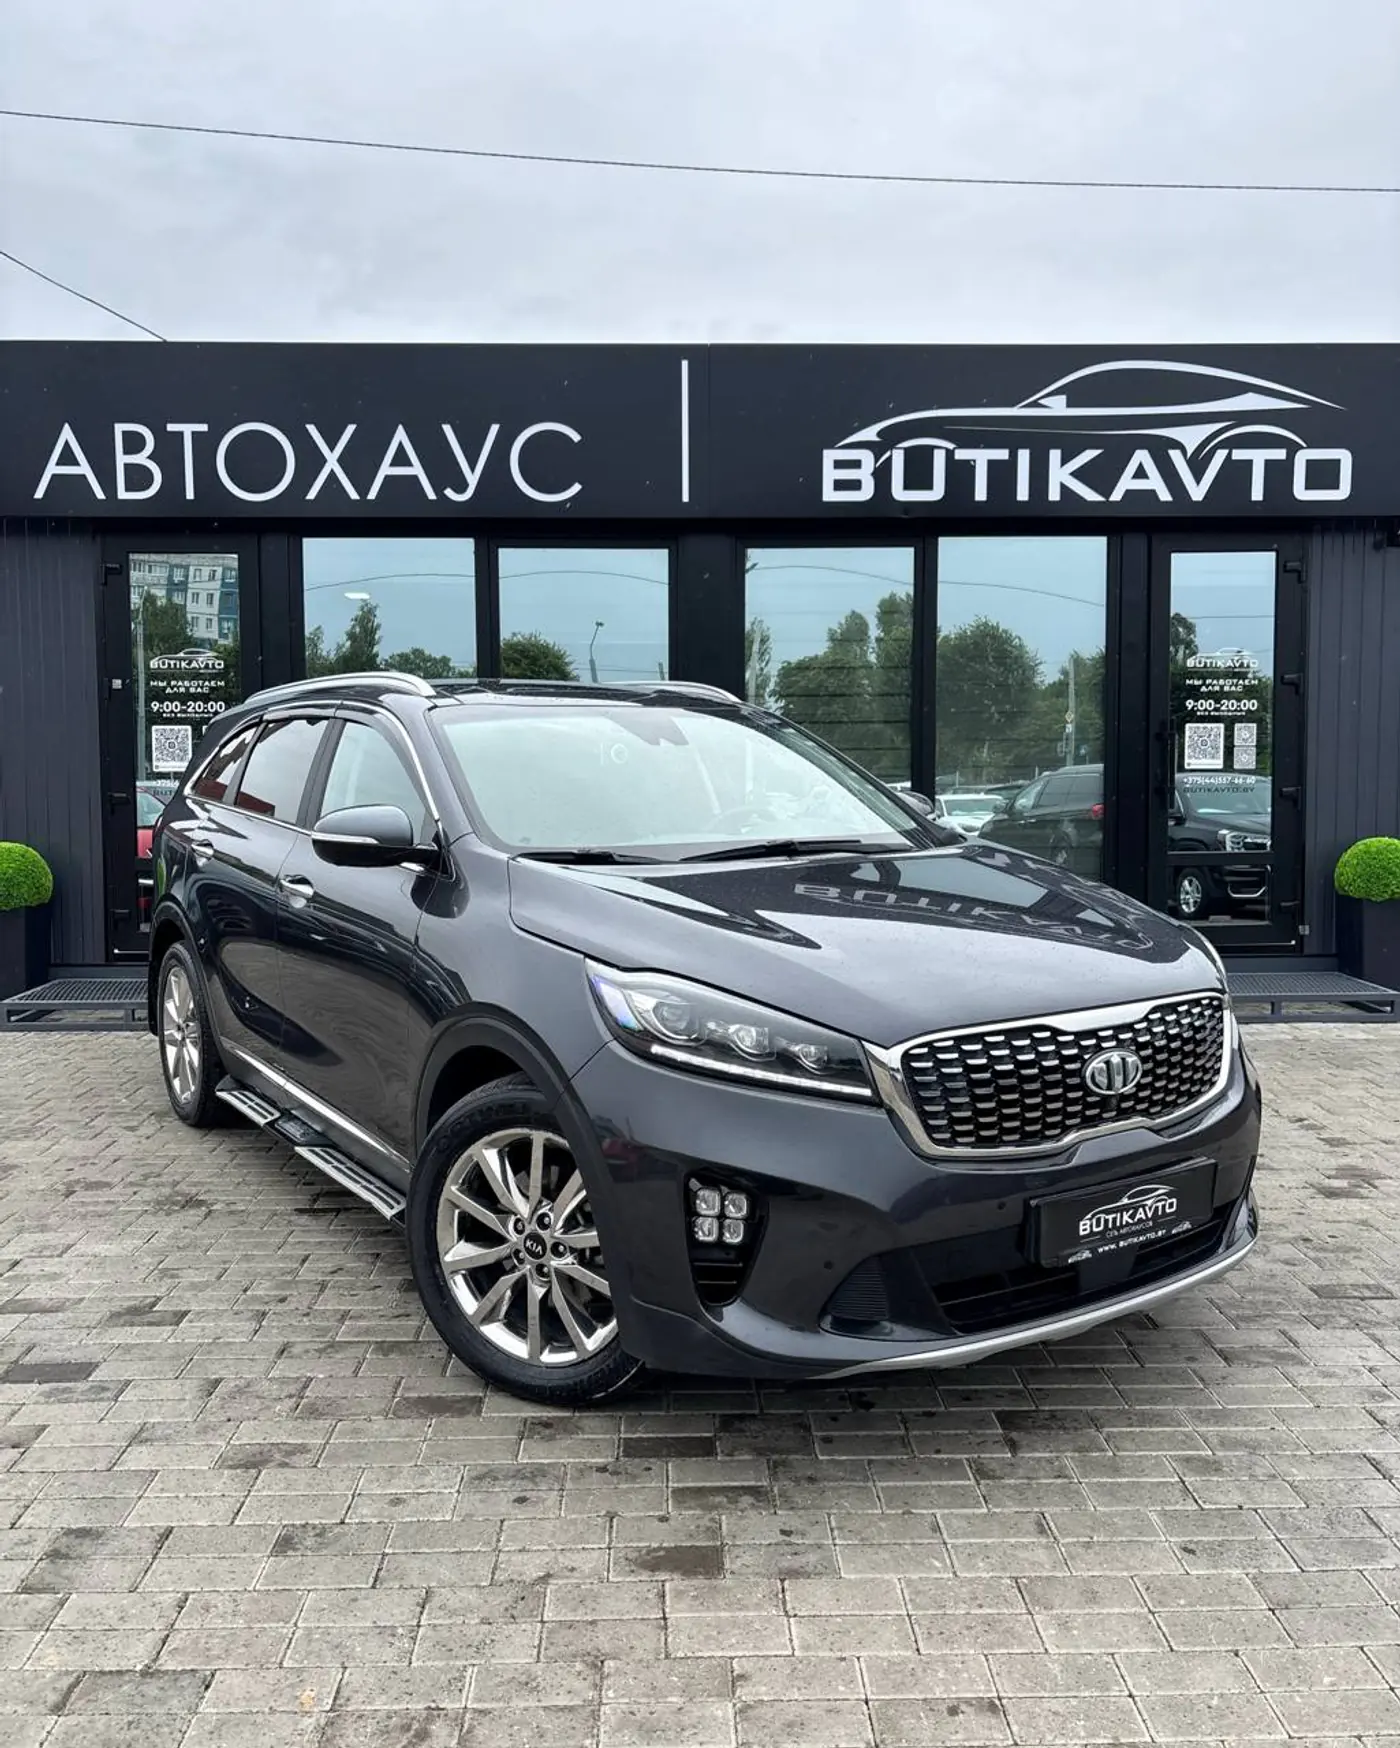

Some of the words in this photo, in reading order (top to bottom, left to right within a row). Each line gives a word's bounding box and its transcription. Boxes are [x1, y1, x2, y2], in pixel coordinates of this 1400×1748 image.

[33, 421, 584, 503] АВТОХАУС
[821, 446, 1354, 503] BUTIKAVTO
[150, 659, 224, 669] BUTIKAVTO
[1186, 658, 1259, 668] BUTIKAVTO
[1185, 678, 1203, 686] МЫ
[1206, 678, 1258, 686] РАБОТАЕМ
[151, 701, 226, 713] 9:00-20:00
[1185, 699, 1258, 711] 9:00-20:00
[1078, 1198, 1177, 1236] BUTIKAVTO
[526, 1239, 543, 1255] KIA
